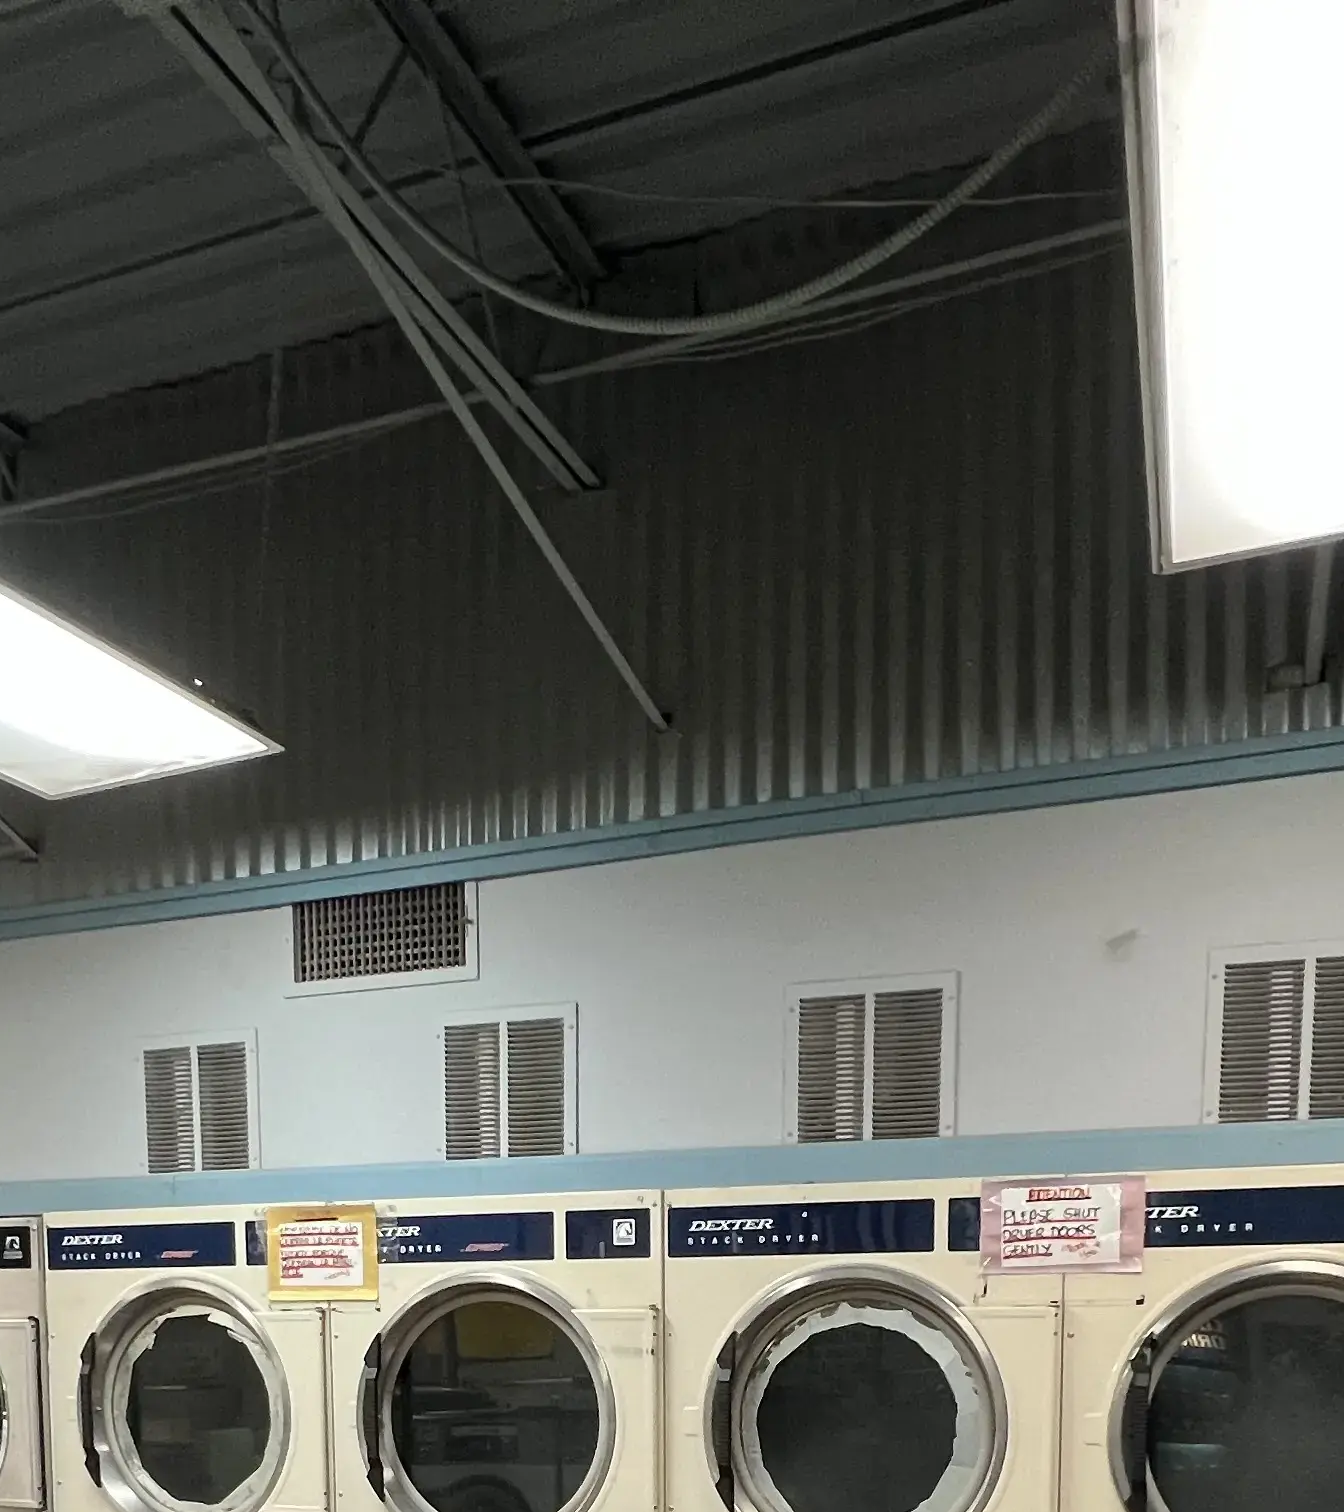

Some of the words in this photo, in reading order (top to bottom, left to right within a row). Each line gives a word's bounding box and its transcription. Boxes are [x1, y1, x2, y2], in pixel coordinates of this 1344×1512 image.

[1003, 1208, 1054, 1224] PLEASE
[1063, 1207, 1101, 1219] SHUT
[1145, 1205, 1199, 1219] TER
[689, 1218, 774, 1231] DEXTER
[1180, 1223, 1253, 1234] DRYER
[1003, 1227, 1044, 1241] DRYER
[1051, 1224, 1095, 1237] DOORS
[61, 1234, 123, 1246] DEXTER
[687, 1235, 744, 1246] STACK
[758, 1234, 819, 1244] DRYER
[1003, 1244, 1052, 1256] GENTLY
